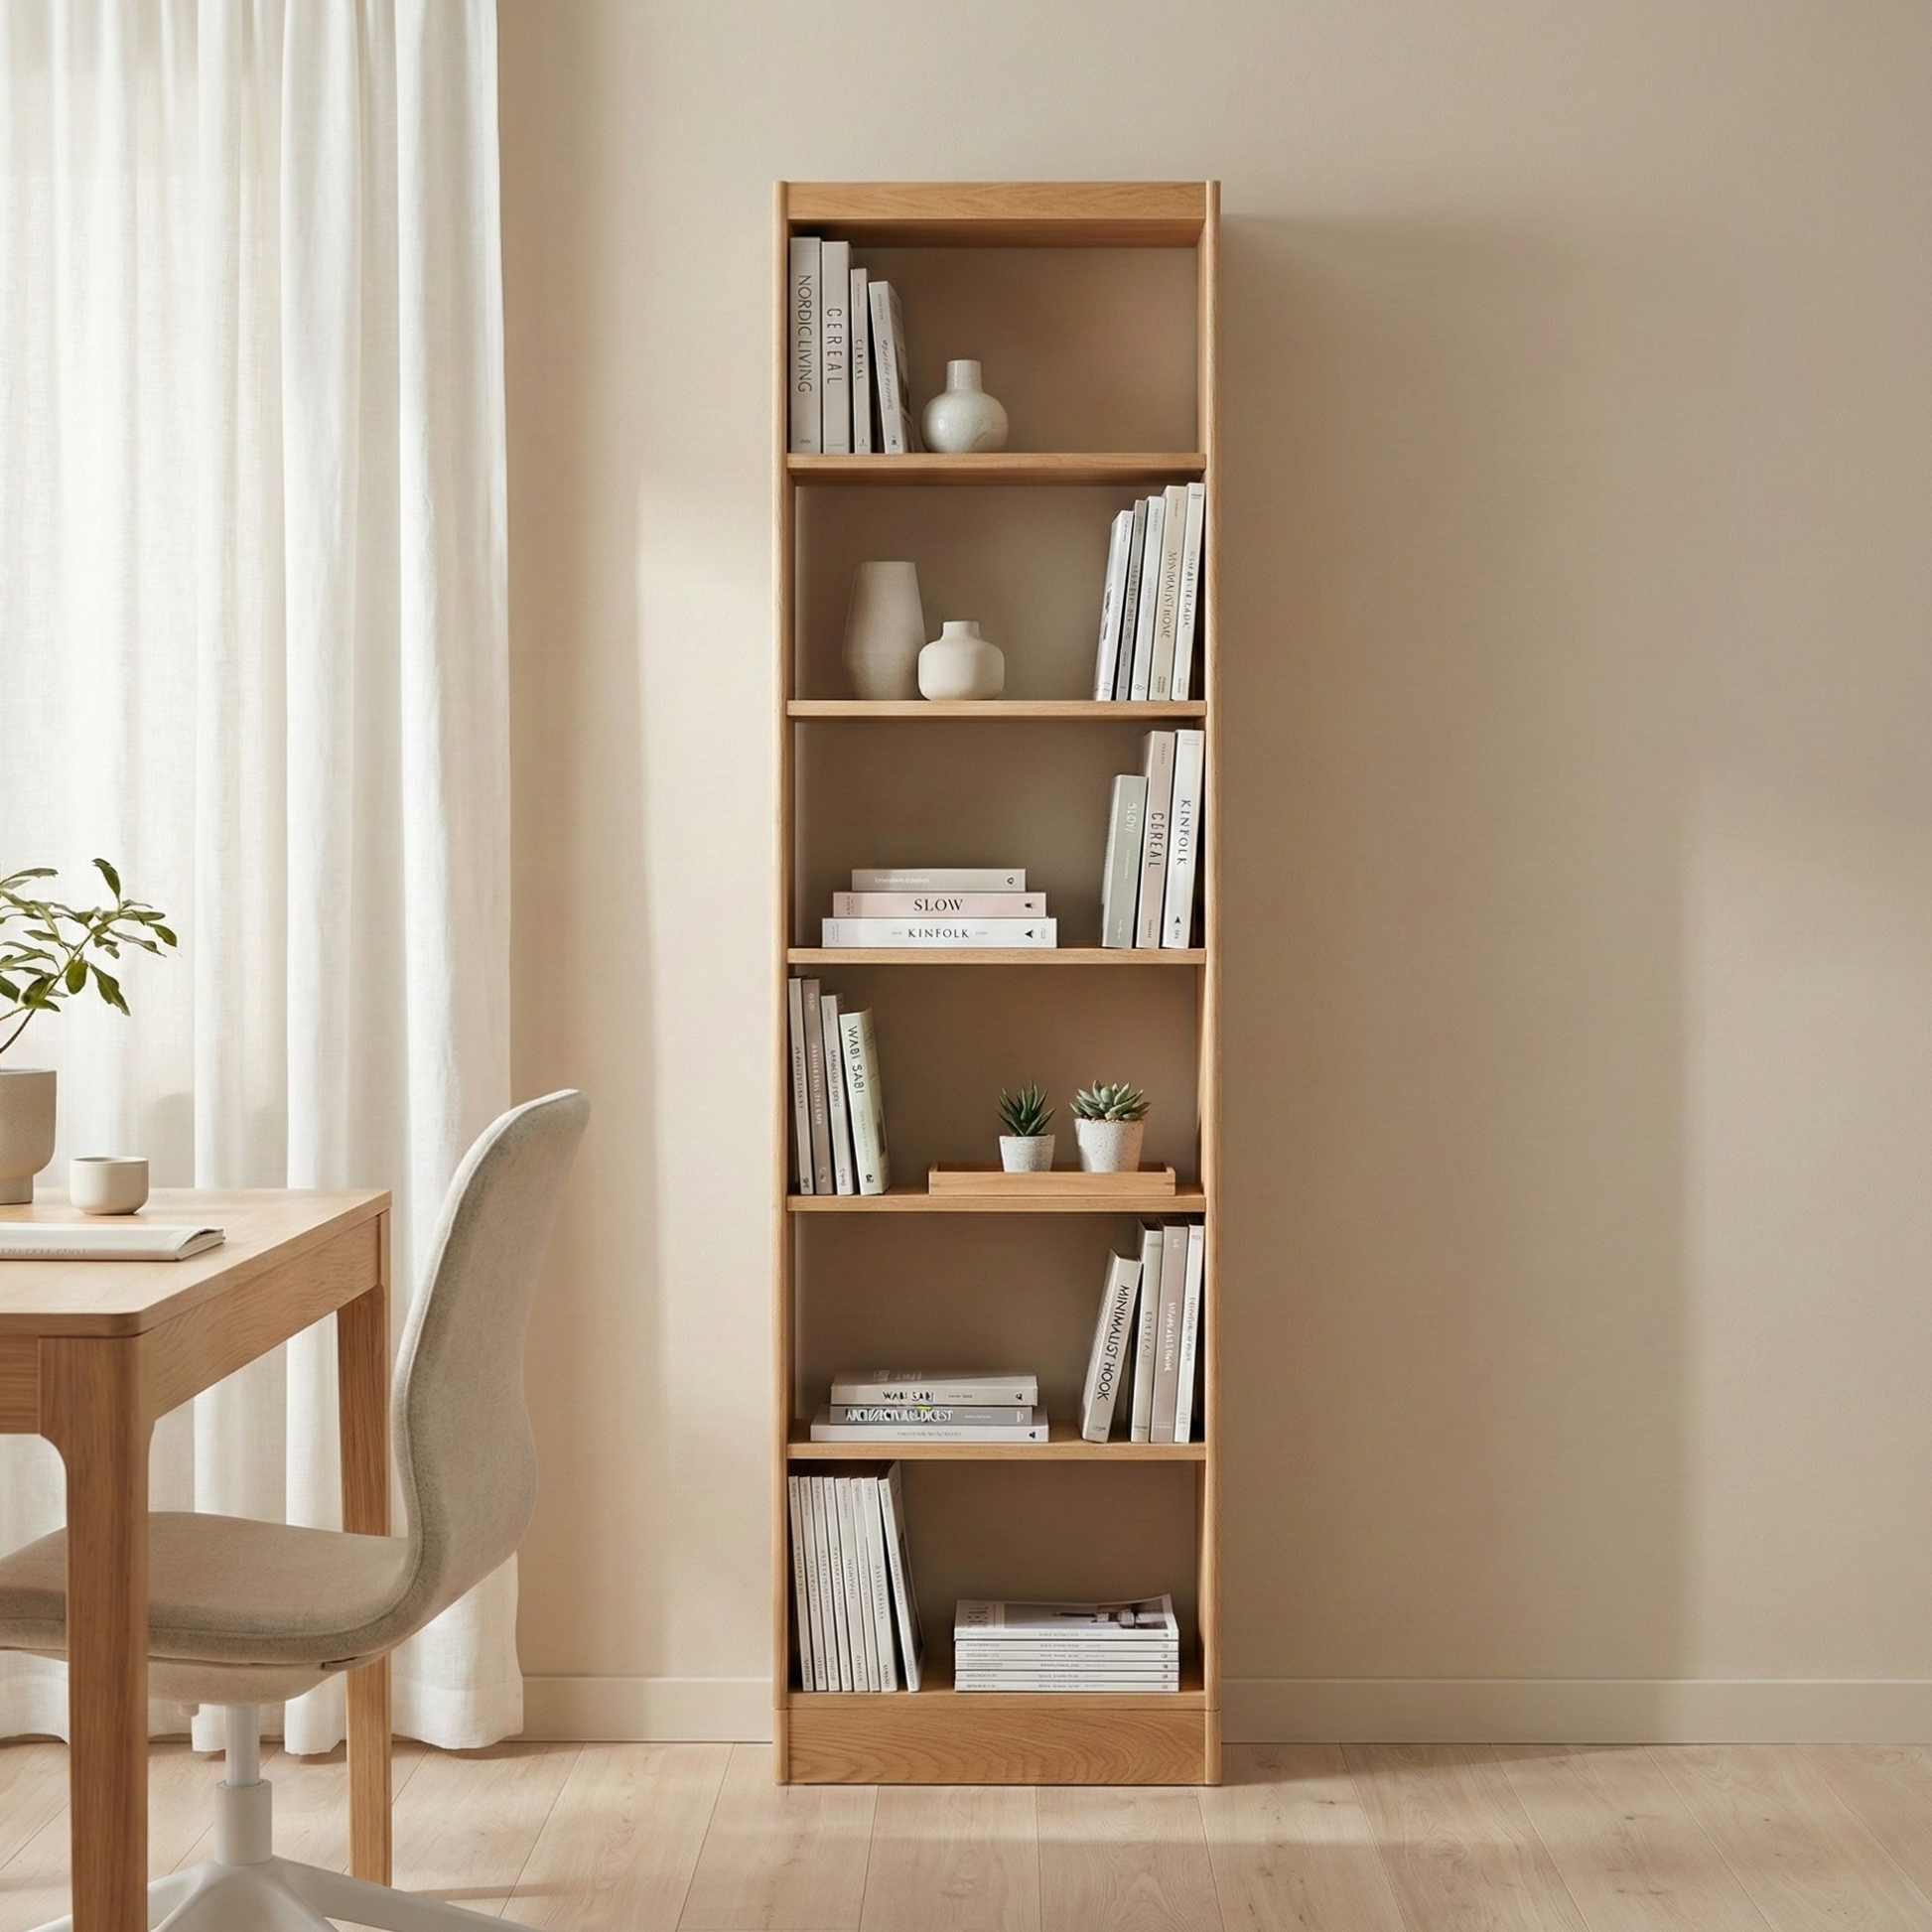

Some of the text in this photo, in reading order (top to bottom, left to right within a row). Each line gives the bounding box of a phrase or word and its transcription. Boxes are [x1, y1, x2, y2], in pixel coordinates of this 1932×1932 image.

[797, 274, 812, 393] NORDIC LIVING
[826, 308, 843, 384] CEREAL
[1176, 798, 1191, 866] KINFOLK
[913, 897, 963, 911] SLOW
[907, 928, 969, 938] KINFOLK
[847, 1025, 861, 1059] WABI
[852, 1063, 866, 1094] SABI
